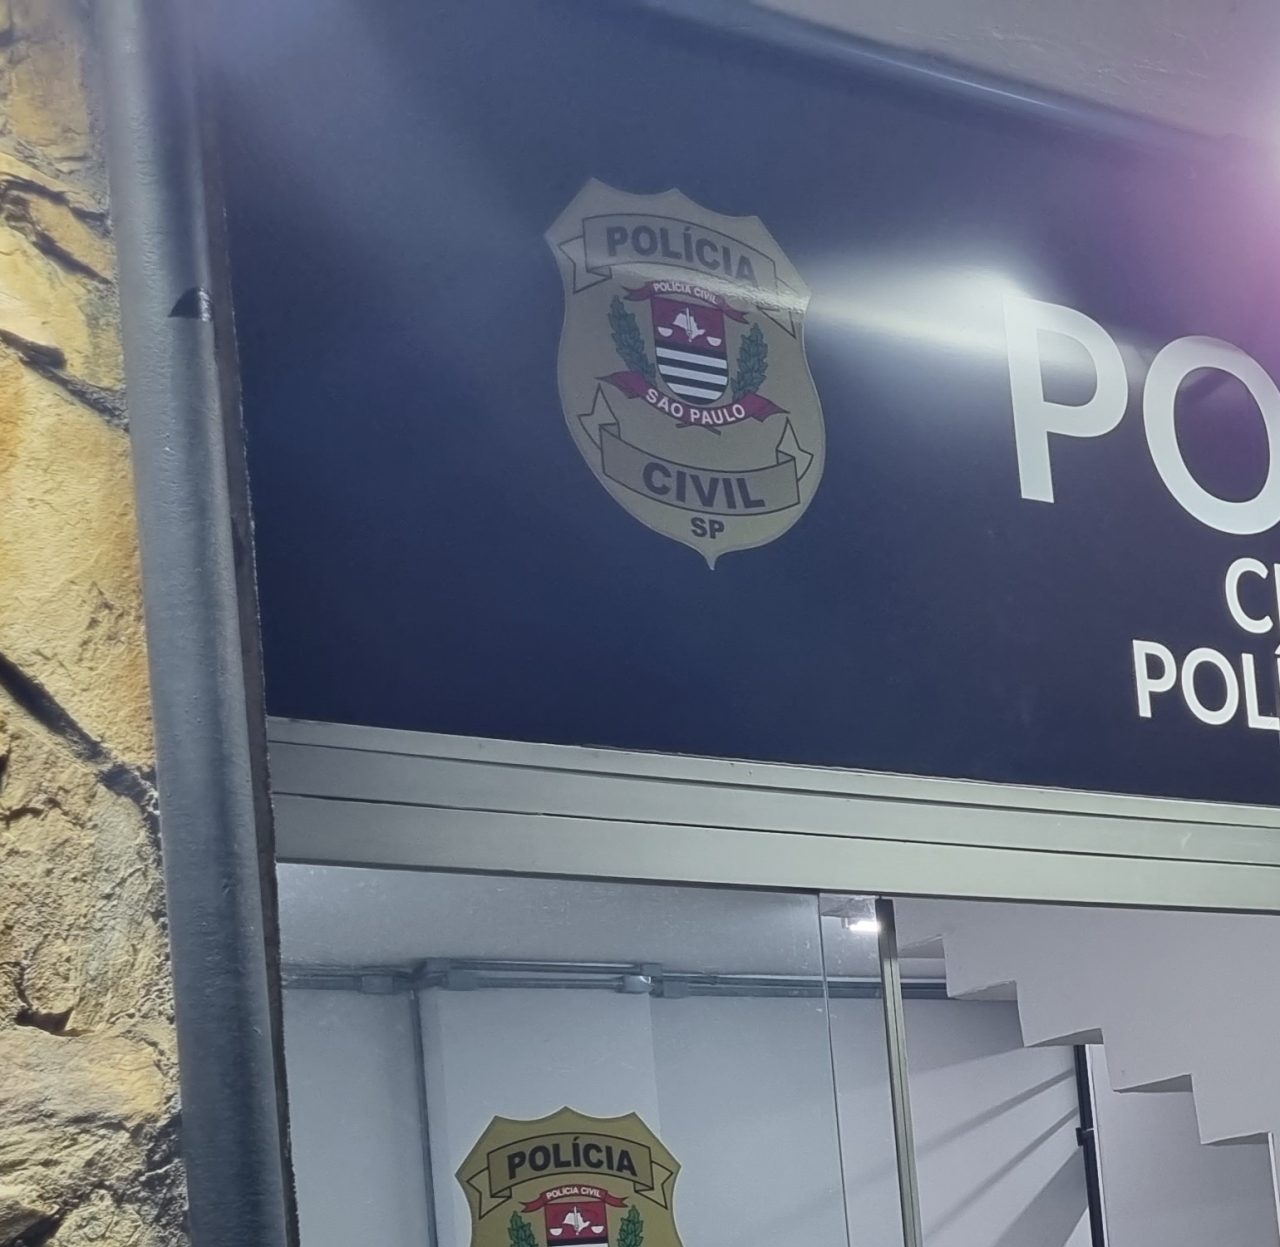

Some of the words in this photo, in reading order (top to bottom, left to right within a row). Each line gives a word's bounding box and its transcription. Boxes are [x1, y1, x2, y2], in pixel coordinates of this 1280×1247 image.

[606, 225, 757, 283] POLÍCIA
[690, 404, 745, 425] PAULO
[642, 462, 766, 509] CIVIL
[690, 517, 725, 539] SP
[507, 1137, 638, 1180] POLÍCIA
